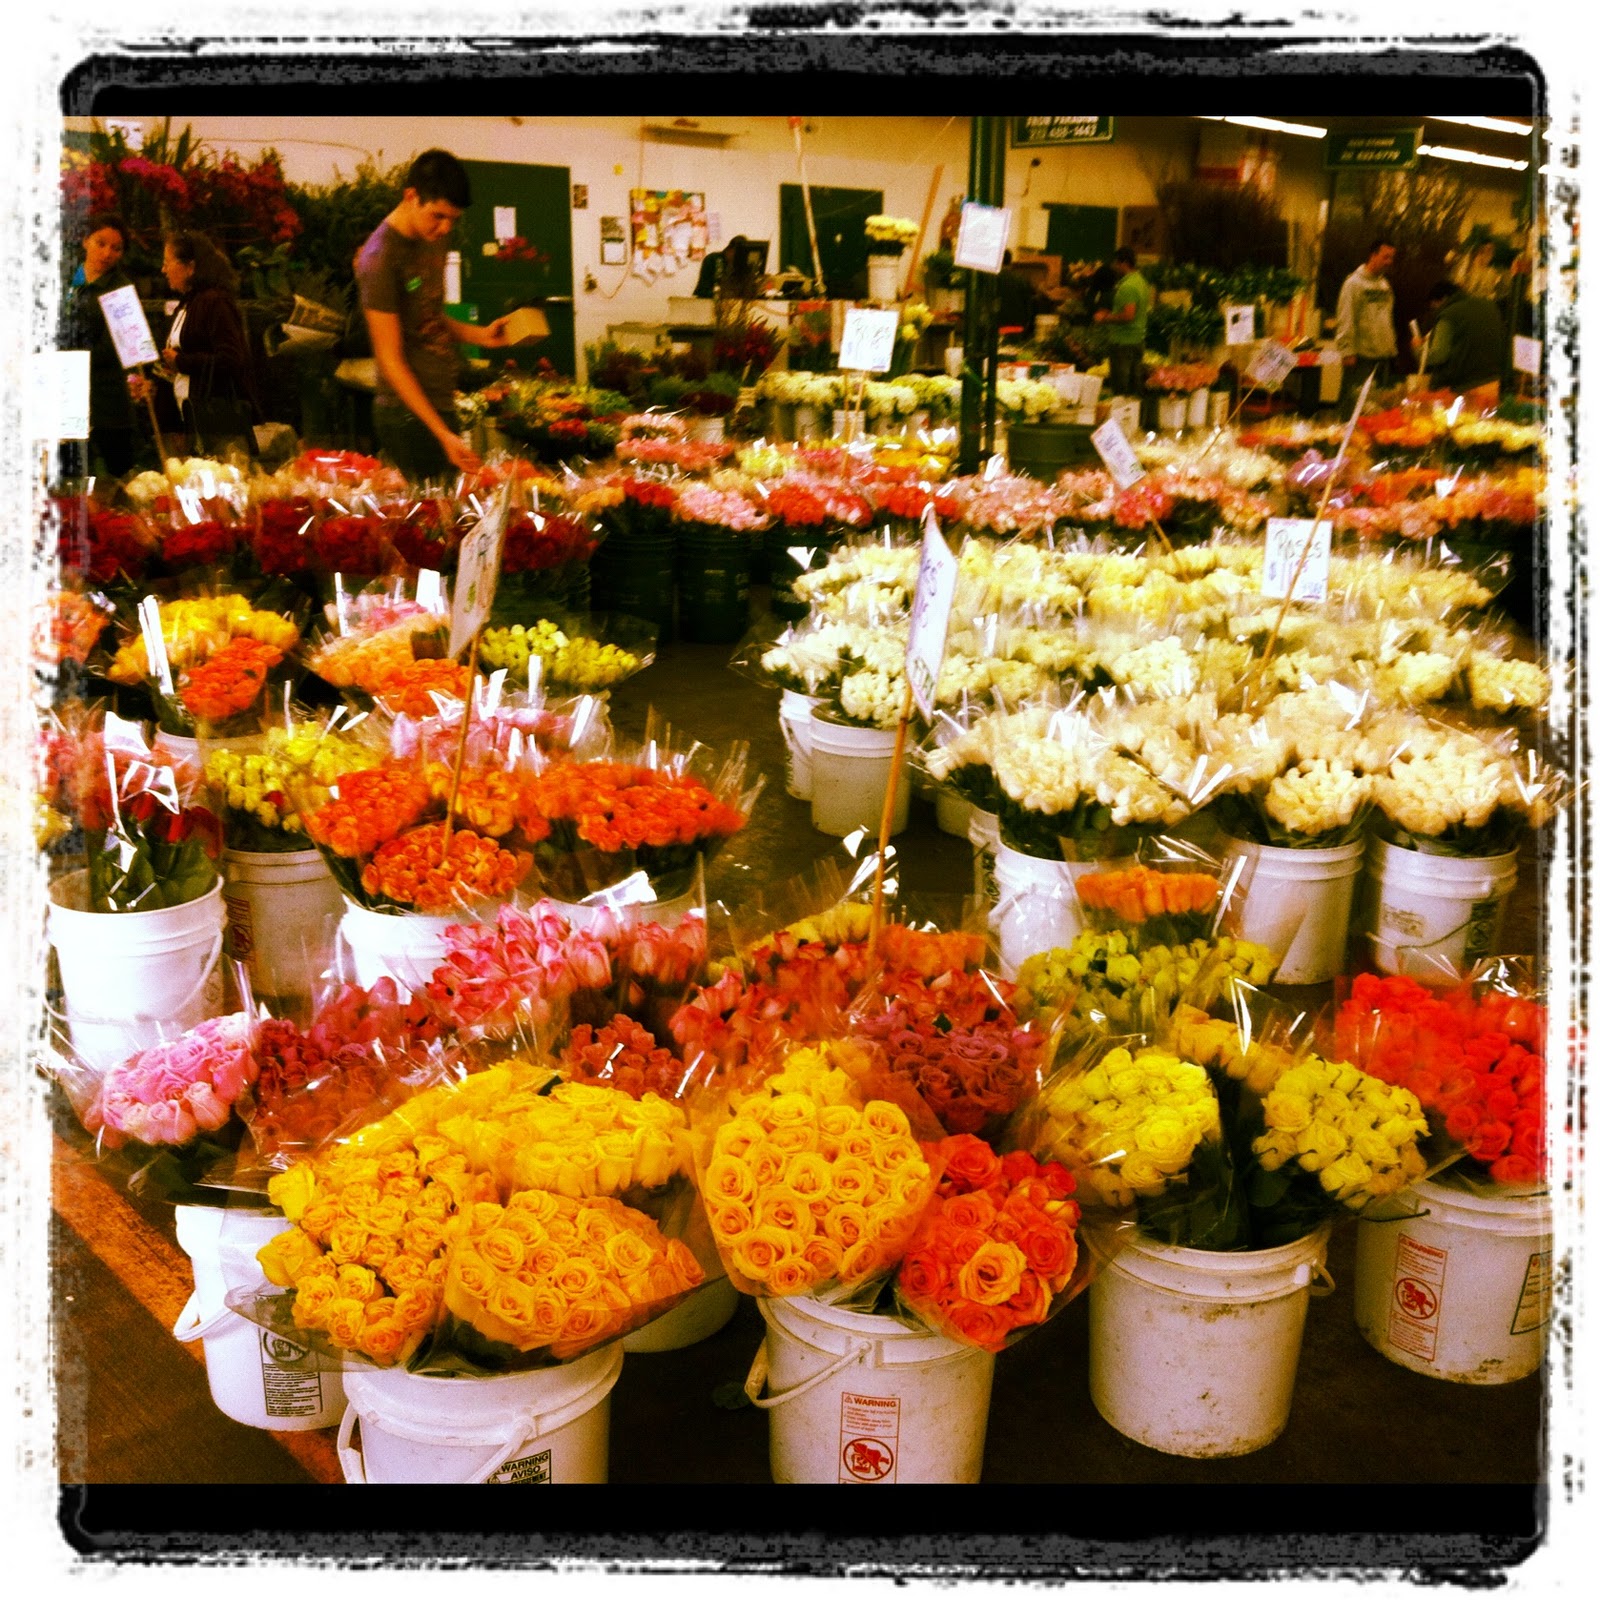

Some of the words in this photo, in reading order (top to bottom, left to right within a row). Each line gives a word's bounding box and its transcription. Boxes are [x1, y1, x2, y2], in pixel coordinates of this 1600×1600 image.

[853, 1397, 897, 1408] WARNING
[501, 1452, 549, 1472] WARNING
[511, 1465, 541, 1481] AVISO
